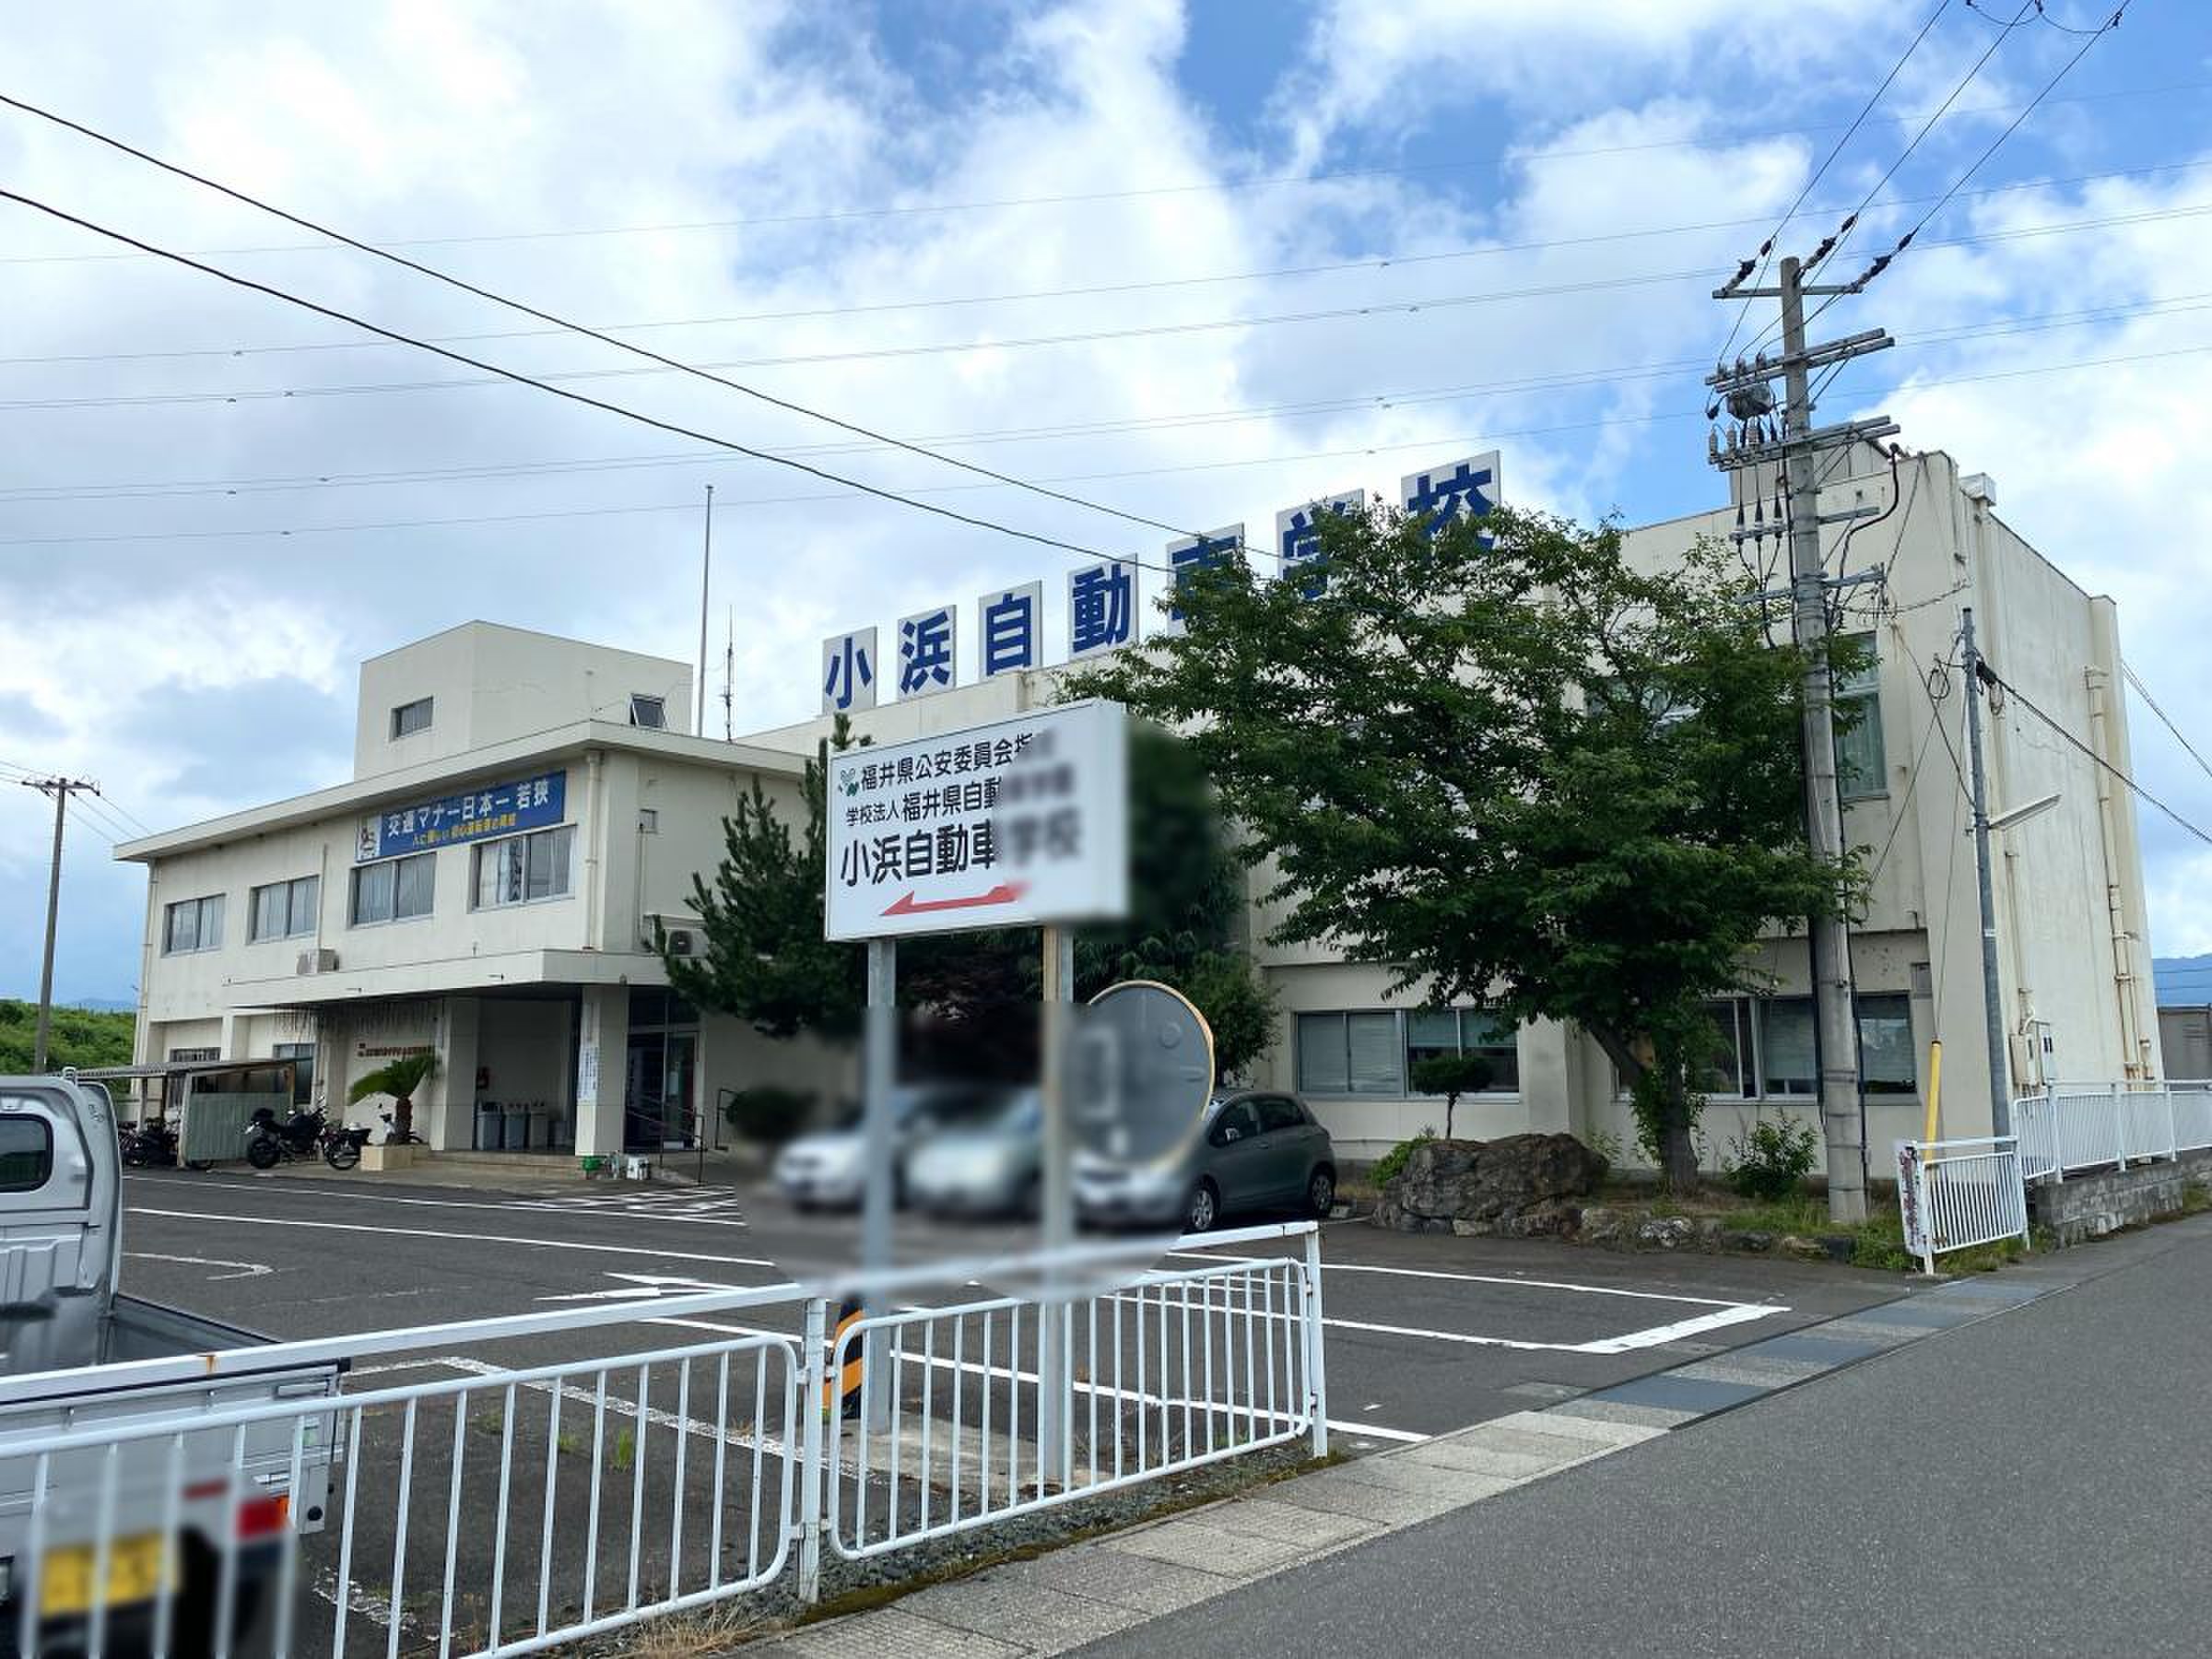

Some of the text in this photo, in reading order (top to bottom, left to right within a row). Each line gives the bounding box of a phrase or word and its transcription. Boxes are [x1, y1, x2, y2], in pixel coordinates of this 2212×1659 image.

[861, 727, 1057, 791] 福井県公安委員会
[840, 807, 1082, 887] 小浜自動車
